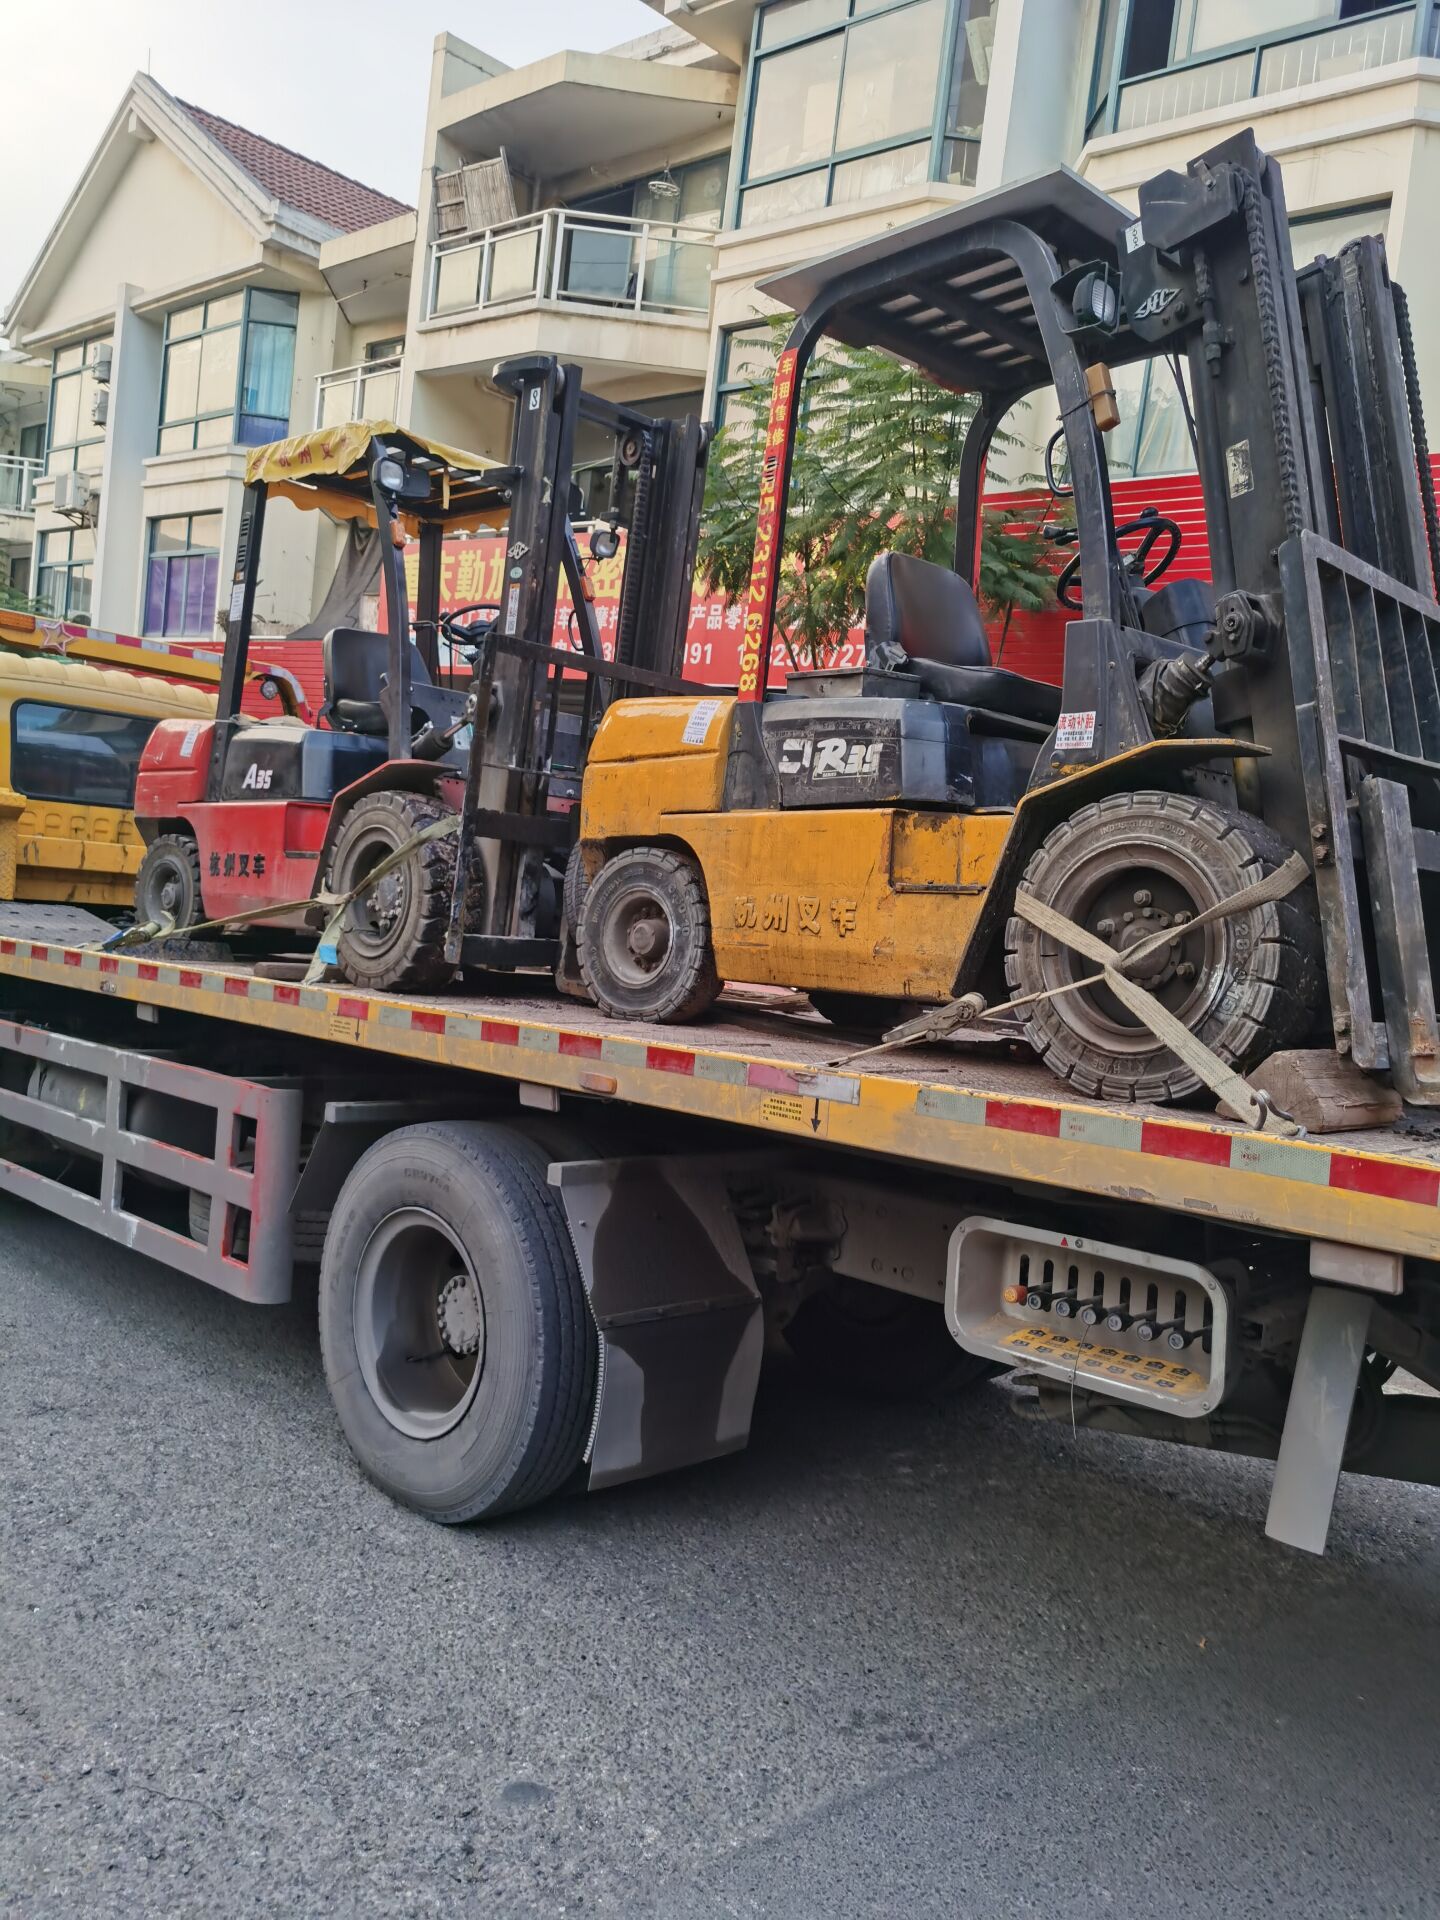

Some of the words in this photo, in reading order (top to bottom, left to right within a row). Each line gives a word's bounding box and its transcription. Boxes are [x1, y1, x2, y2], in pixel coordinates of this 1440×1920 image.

[749, 524, 773, 604] 2312
[739, 612, 764, 692] 6268
[241, 763, 273, 789] A35
[209, 852, 266, 879] 杭州叉车
[734, 893, 858, 938] 杭州叉车
